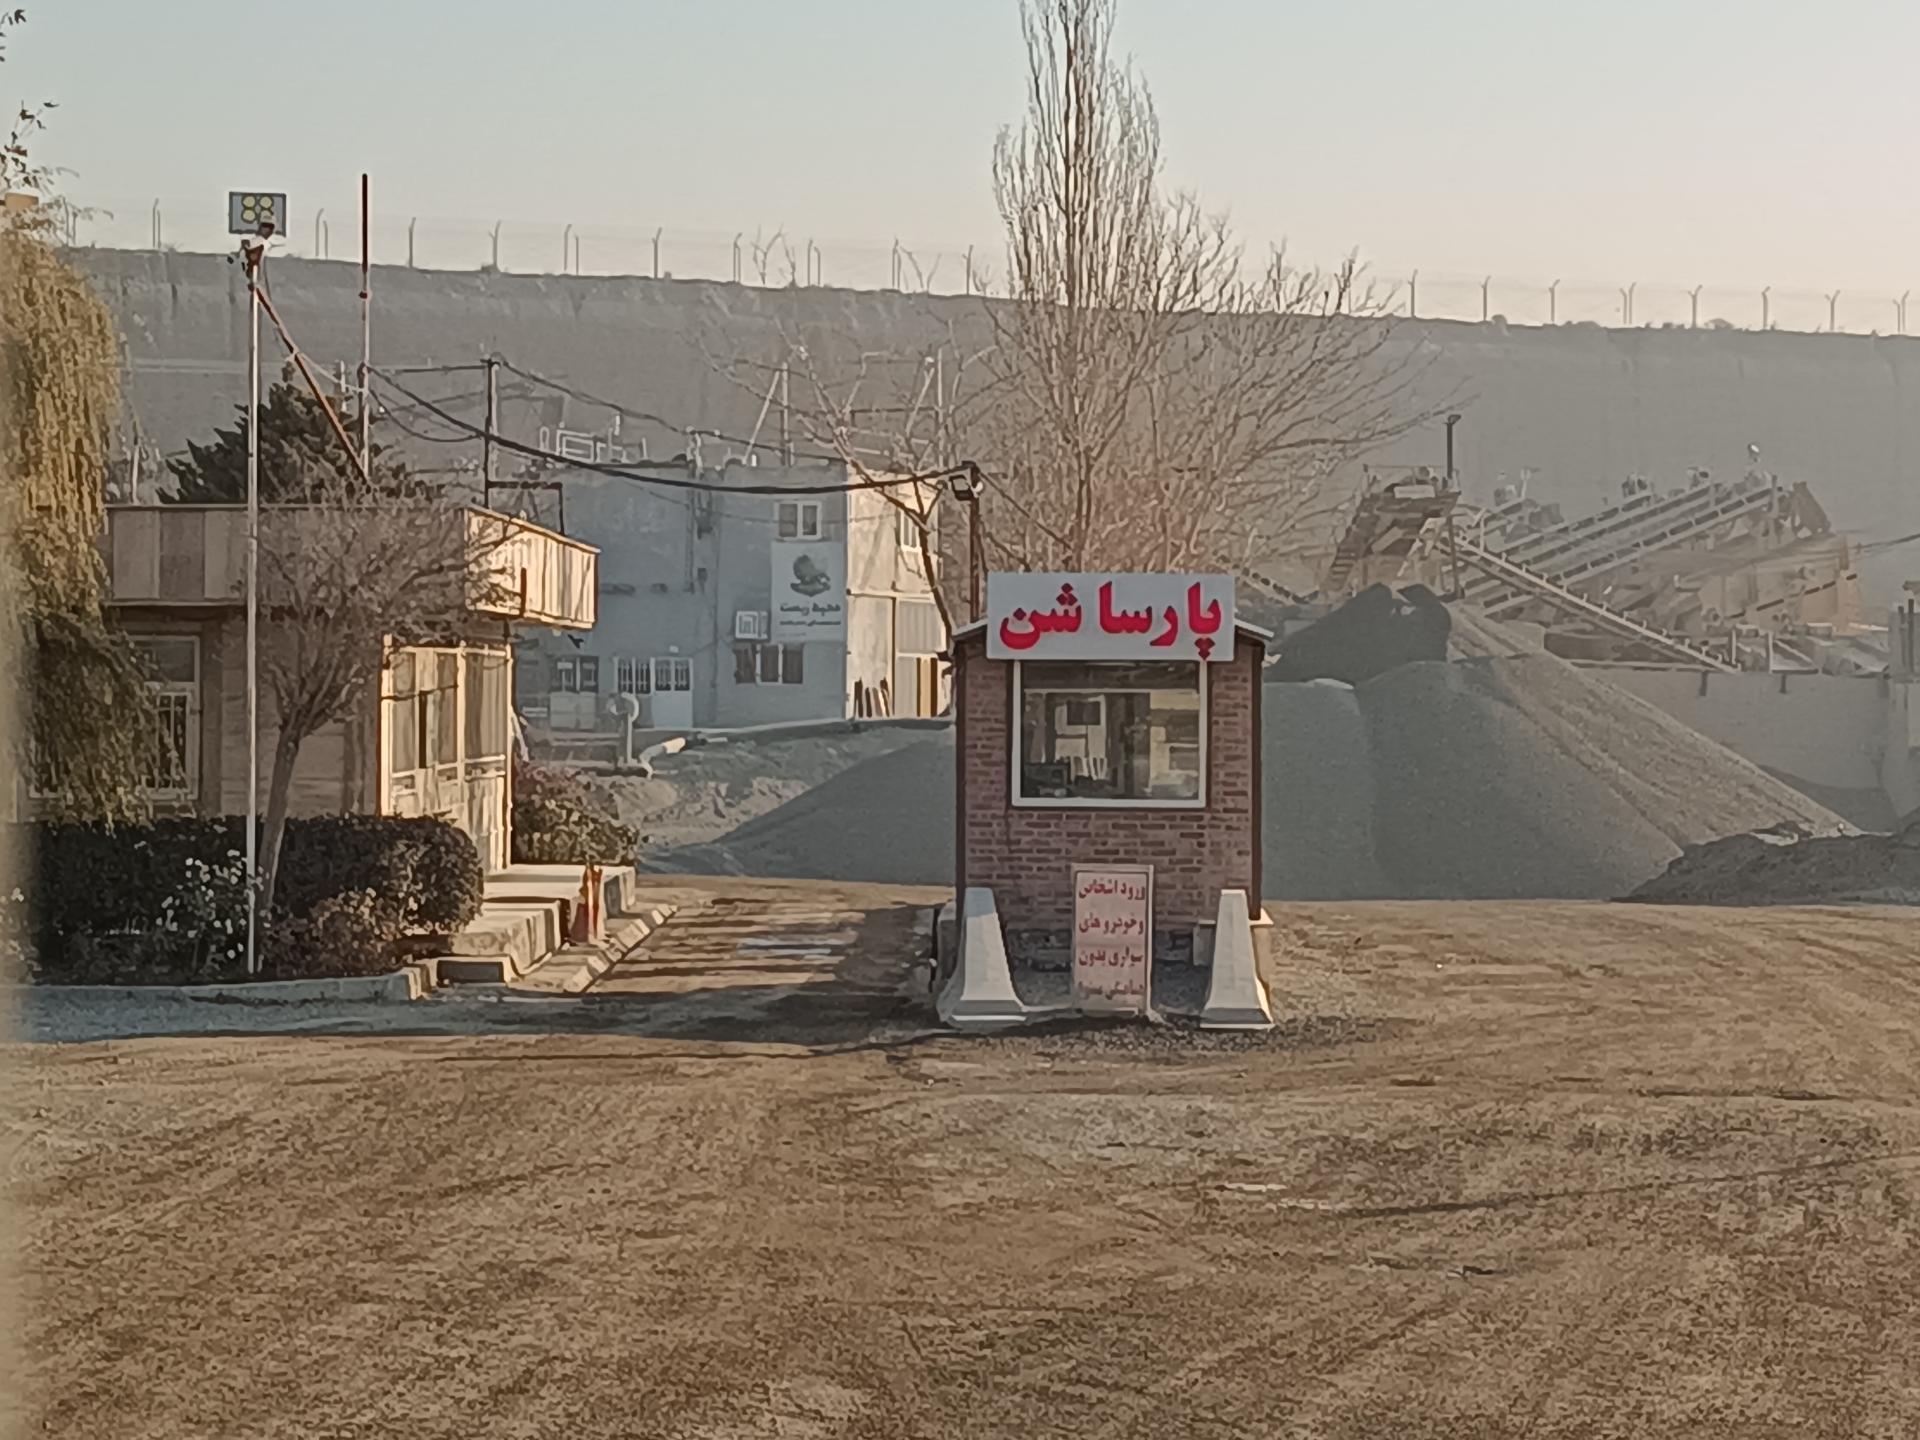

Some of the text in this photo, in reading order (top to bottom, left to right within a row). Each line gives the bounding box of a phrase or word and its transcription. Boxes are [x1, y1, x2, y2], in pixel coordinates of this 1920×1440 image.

[1000, 581, 1222, 661] پارسا شن
[1079, 878, 1145, 900] ورود اشخاص
[1079, 946, 1143, 968] سواری بدون
